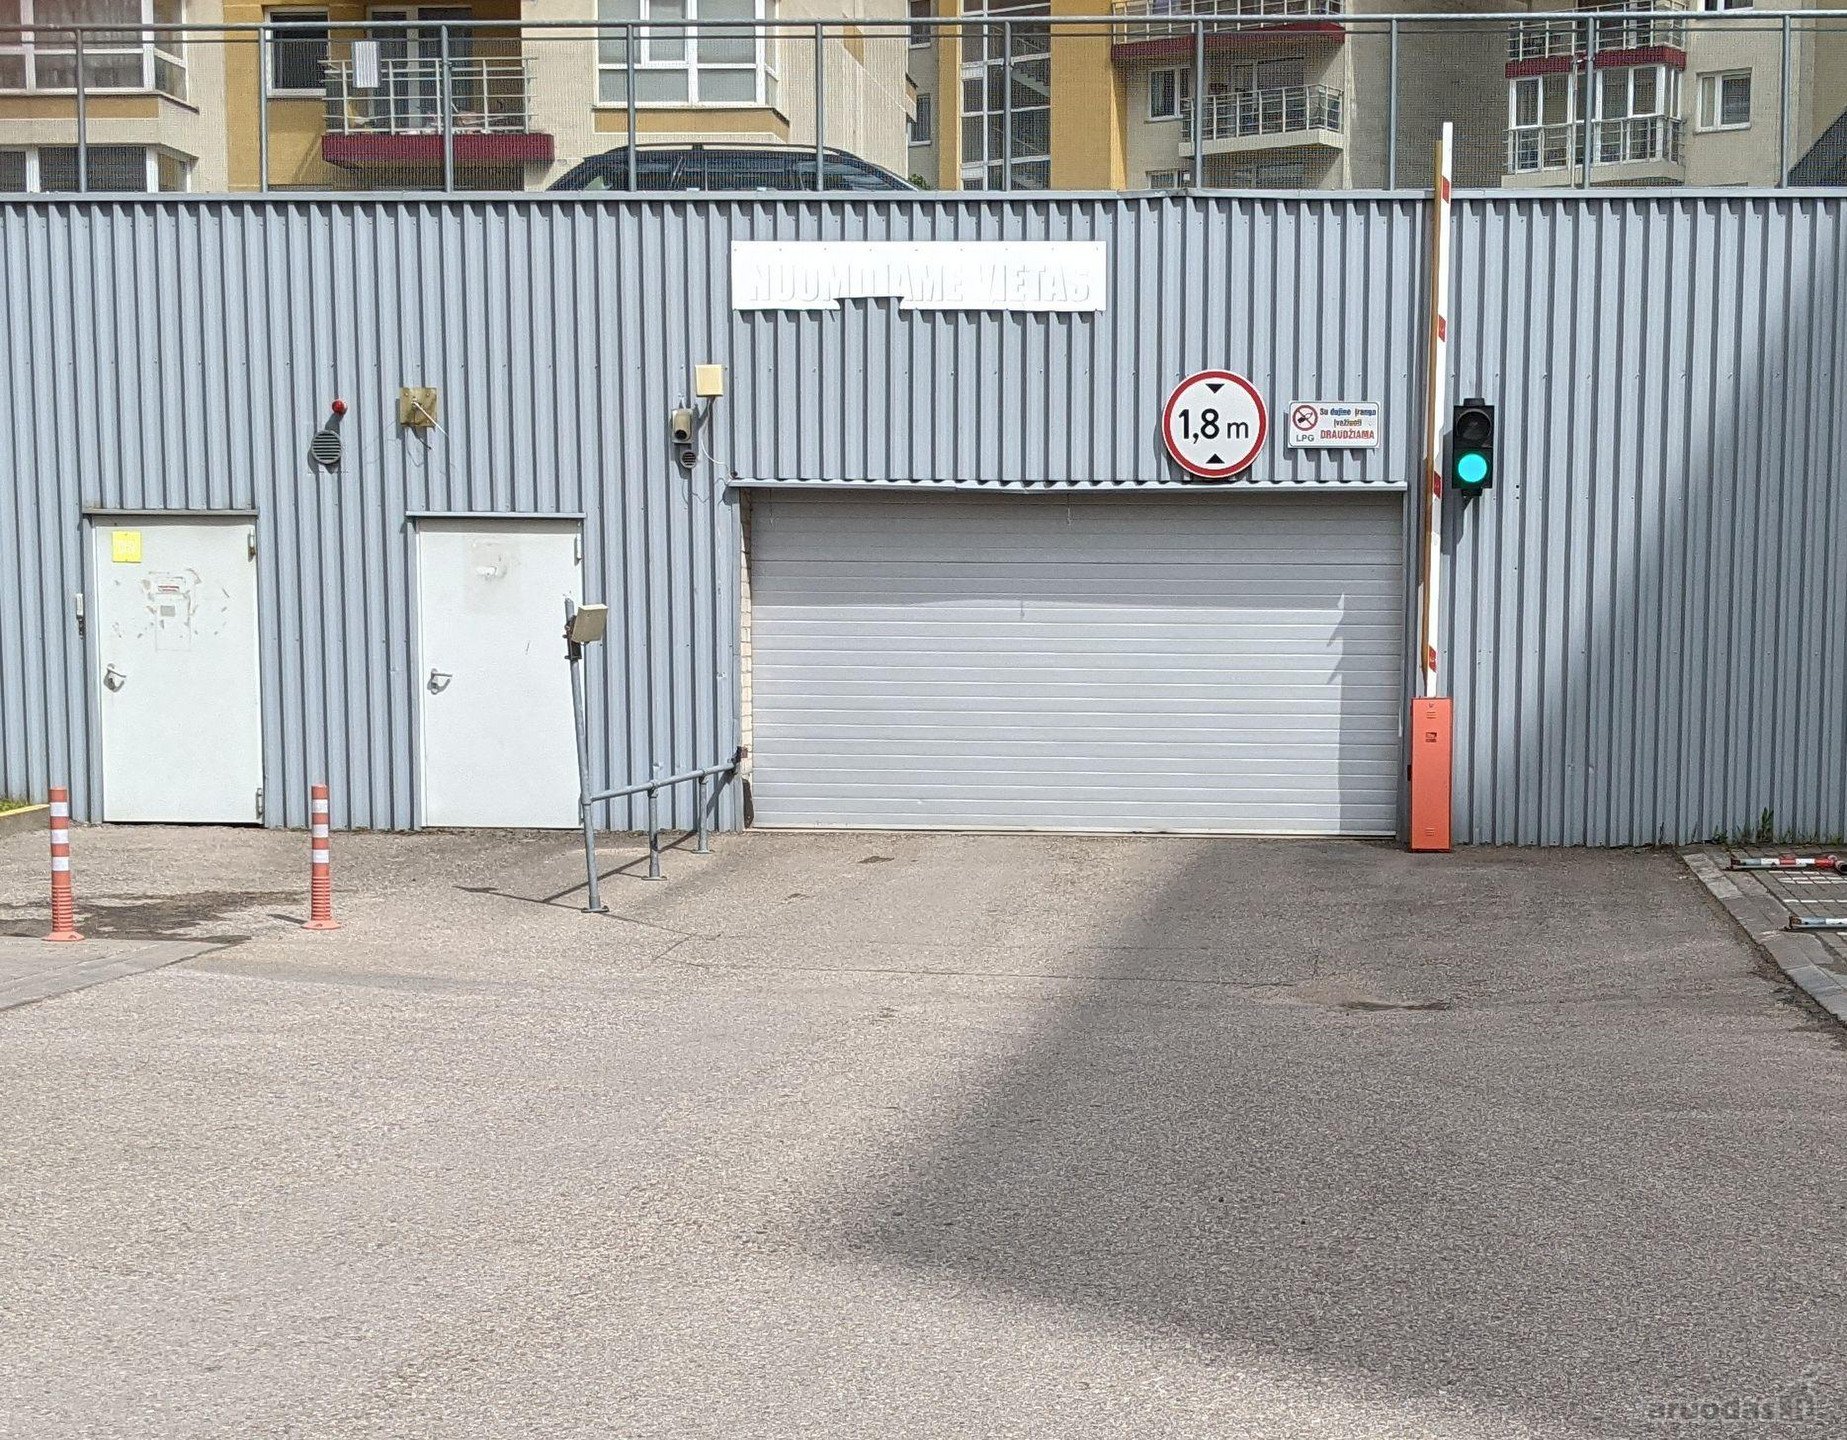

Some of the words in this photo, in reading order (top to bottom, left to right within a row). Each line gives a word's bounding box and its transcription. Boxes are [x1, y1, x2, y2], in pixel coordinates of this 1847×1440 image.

[1319, 408, 1329, 416] Su
[1178, 408, 1220, 444] 1,8
[1227, 421, 1249, 439] m
[1296, 434, 1315, 443] LPG
[1320, 428, 1375, 440] DRAUDŽIAMA
